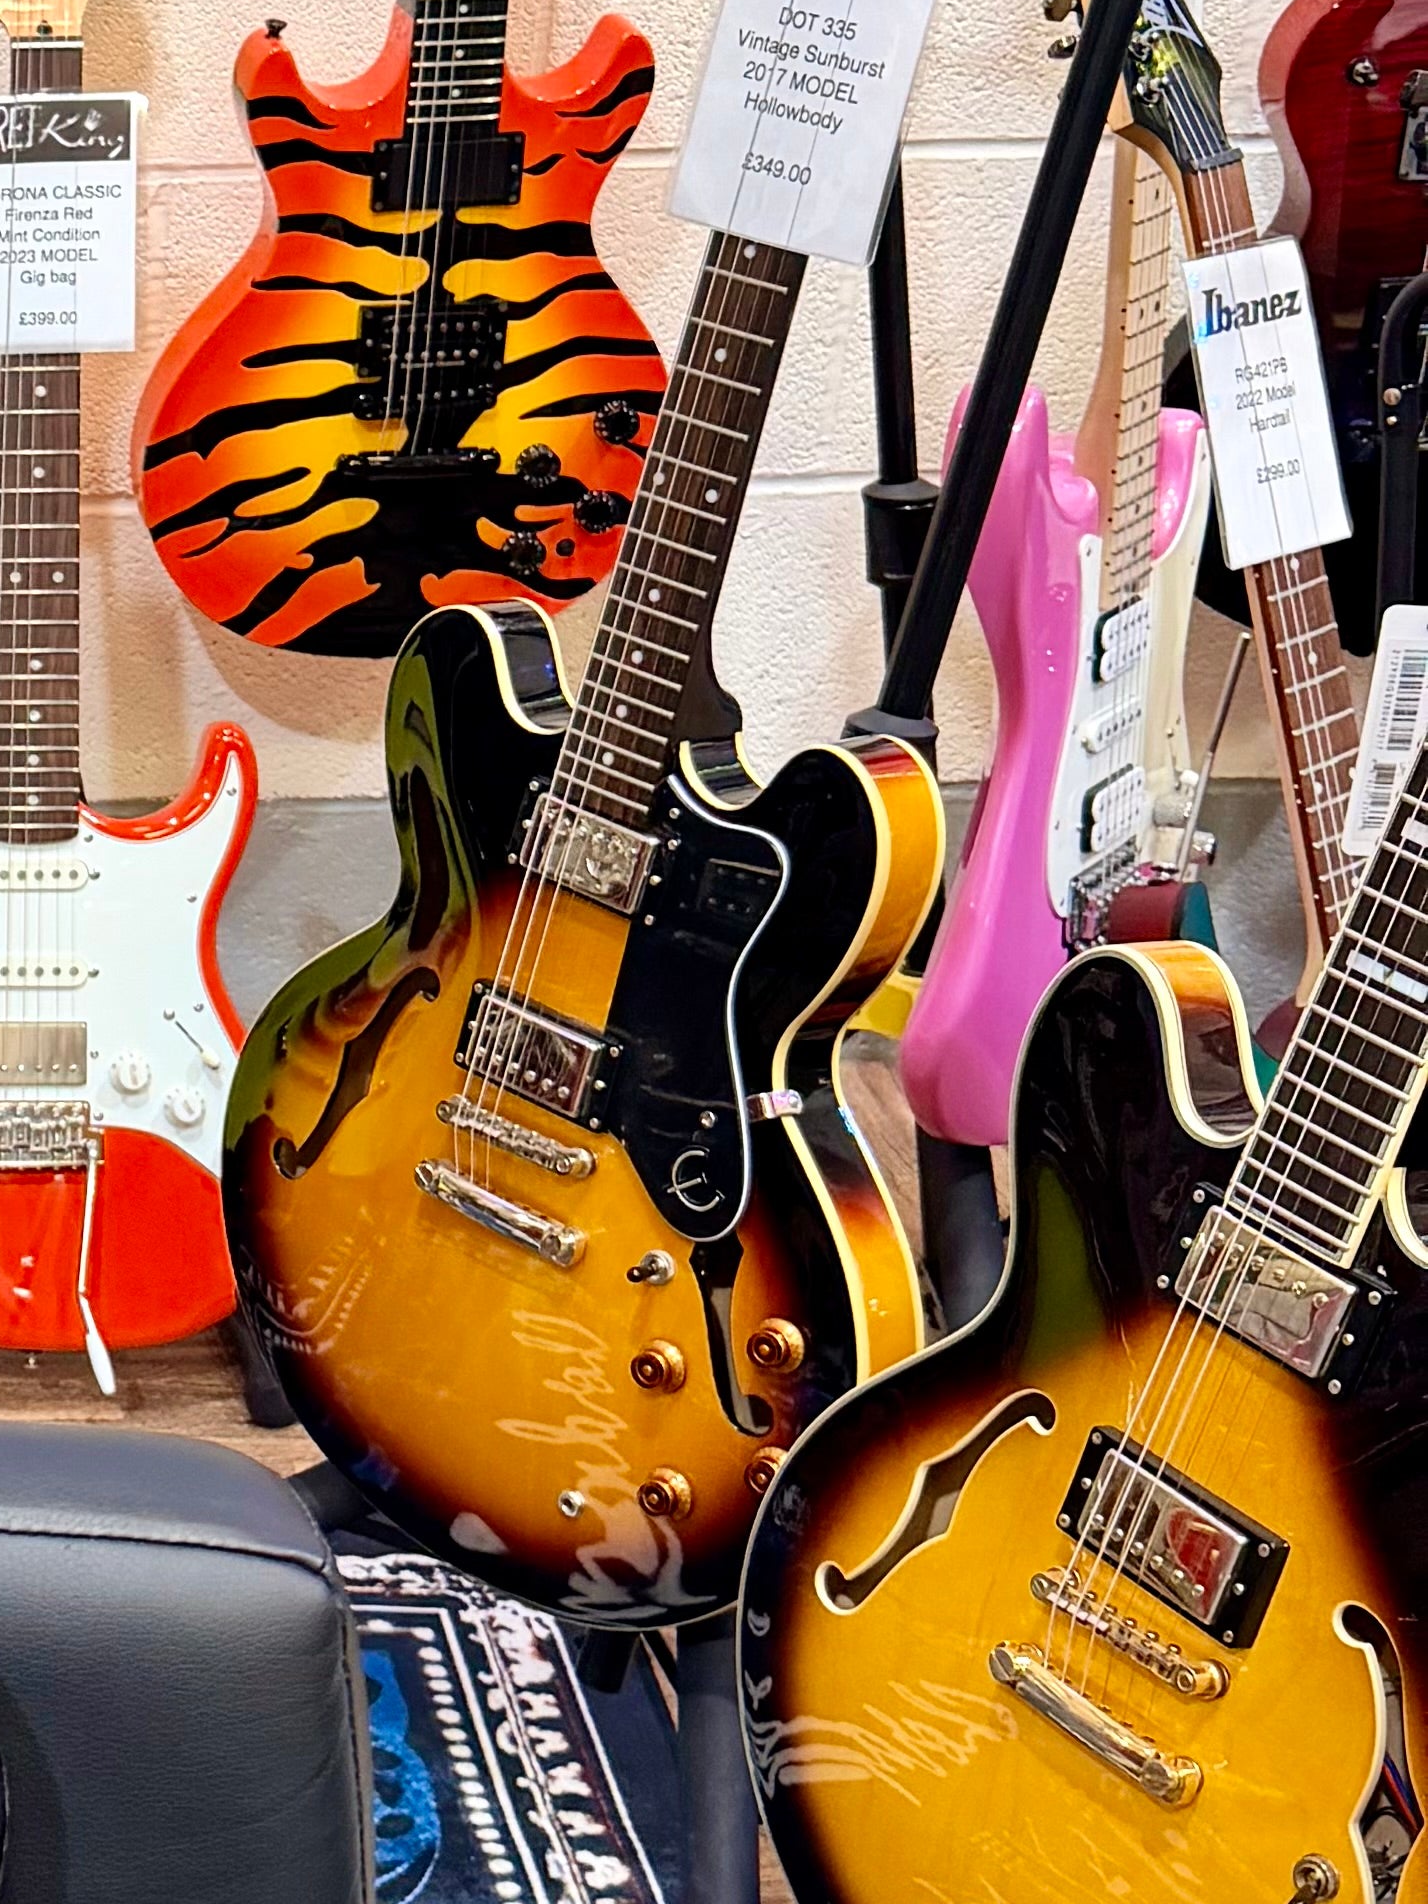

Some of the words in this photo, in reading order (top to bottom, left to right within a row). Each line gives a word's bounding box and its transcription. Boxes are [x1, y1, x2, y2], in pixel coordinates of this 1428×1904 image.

[778, 7, 819, 33] DOT
[821, 16, 858, 40] 335
[737, 29, 800, 60] Vintage
[804, 45, 887, 79] Sunburst
[790, 69, 860, 105] MODEL
[743, 90, 843, 134] Hollowbody
[39, 112, 126, 159] King
[742, 152, 812, 186] £349.00
[52, 184, 122, 200] CLASSIC
[5, 208, 59, 222] Firenza
[64, 207, 94, 220] Red
[32, 228, 100, 242] Condition
[0, 251, 36, 264] 2023
[41, 249, 98, 262] MODEL
[20, 271, 45, 286] Gig
[50, 271, 77, 286] bag
[18, 312, 78, 326] £399.00
[1202, 287, 1303, 338] Ibanez
